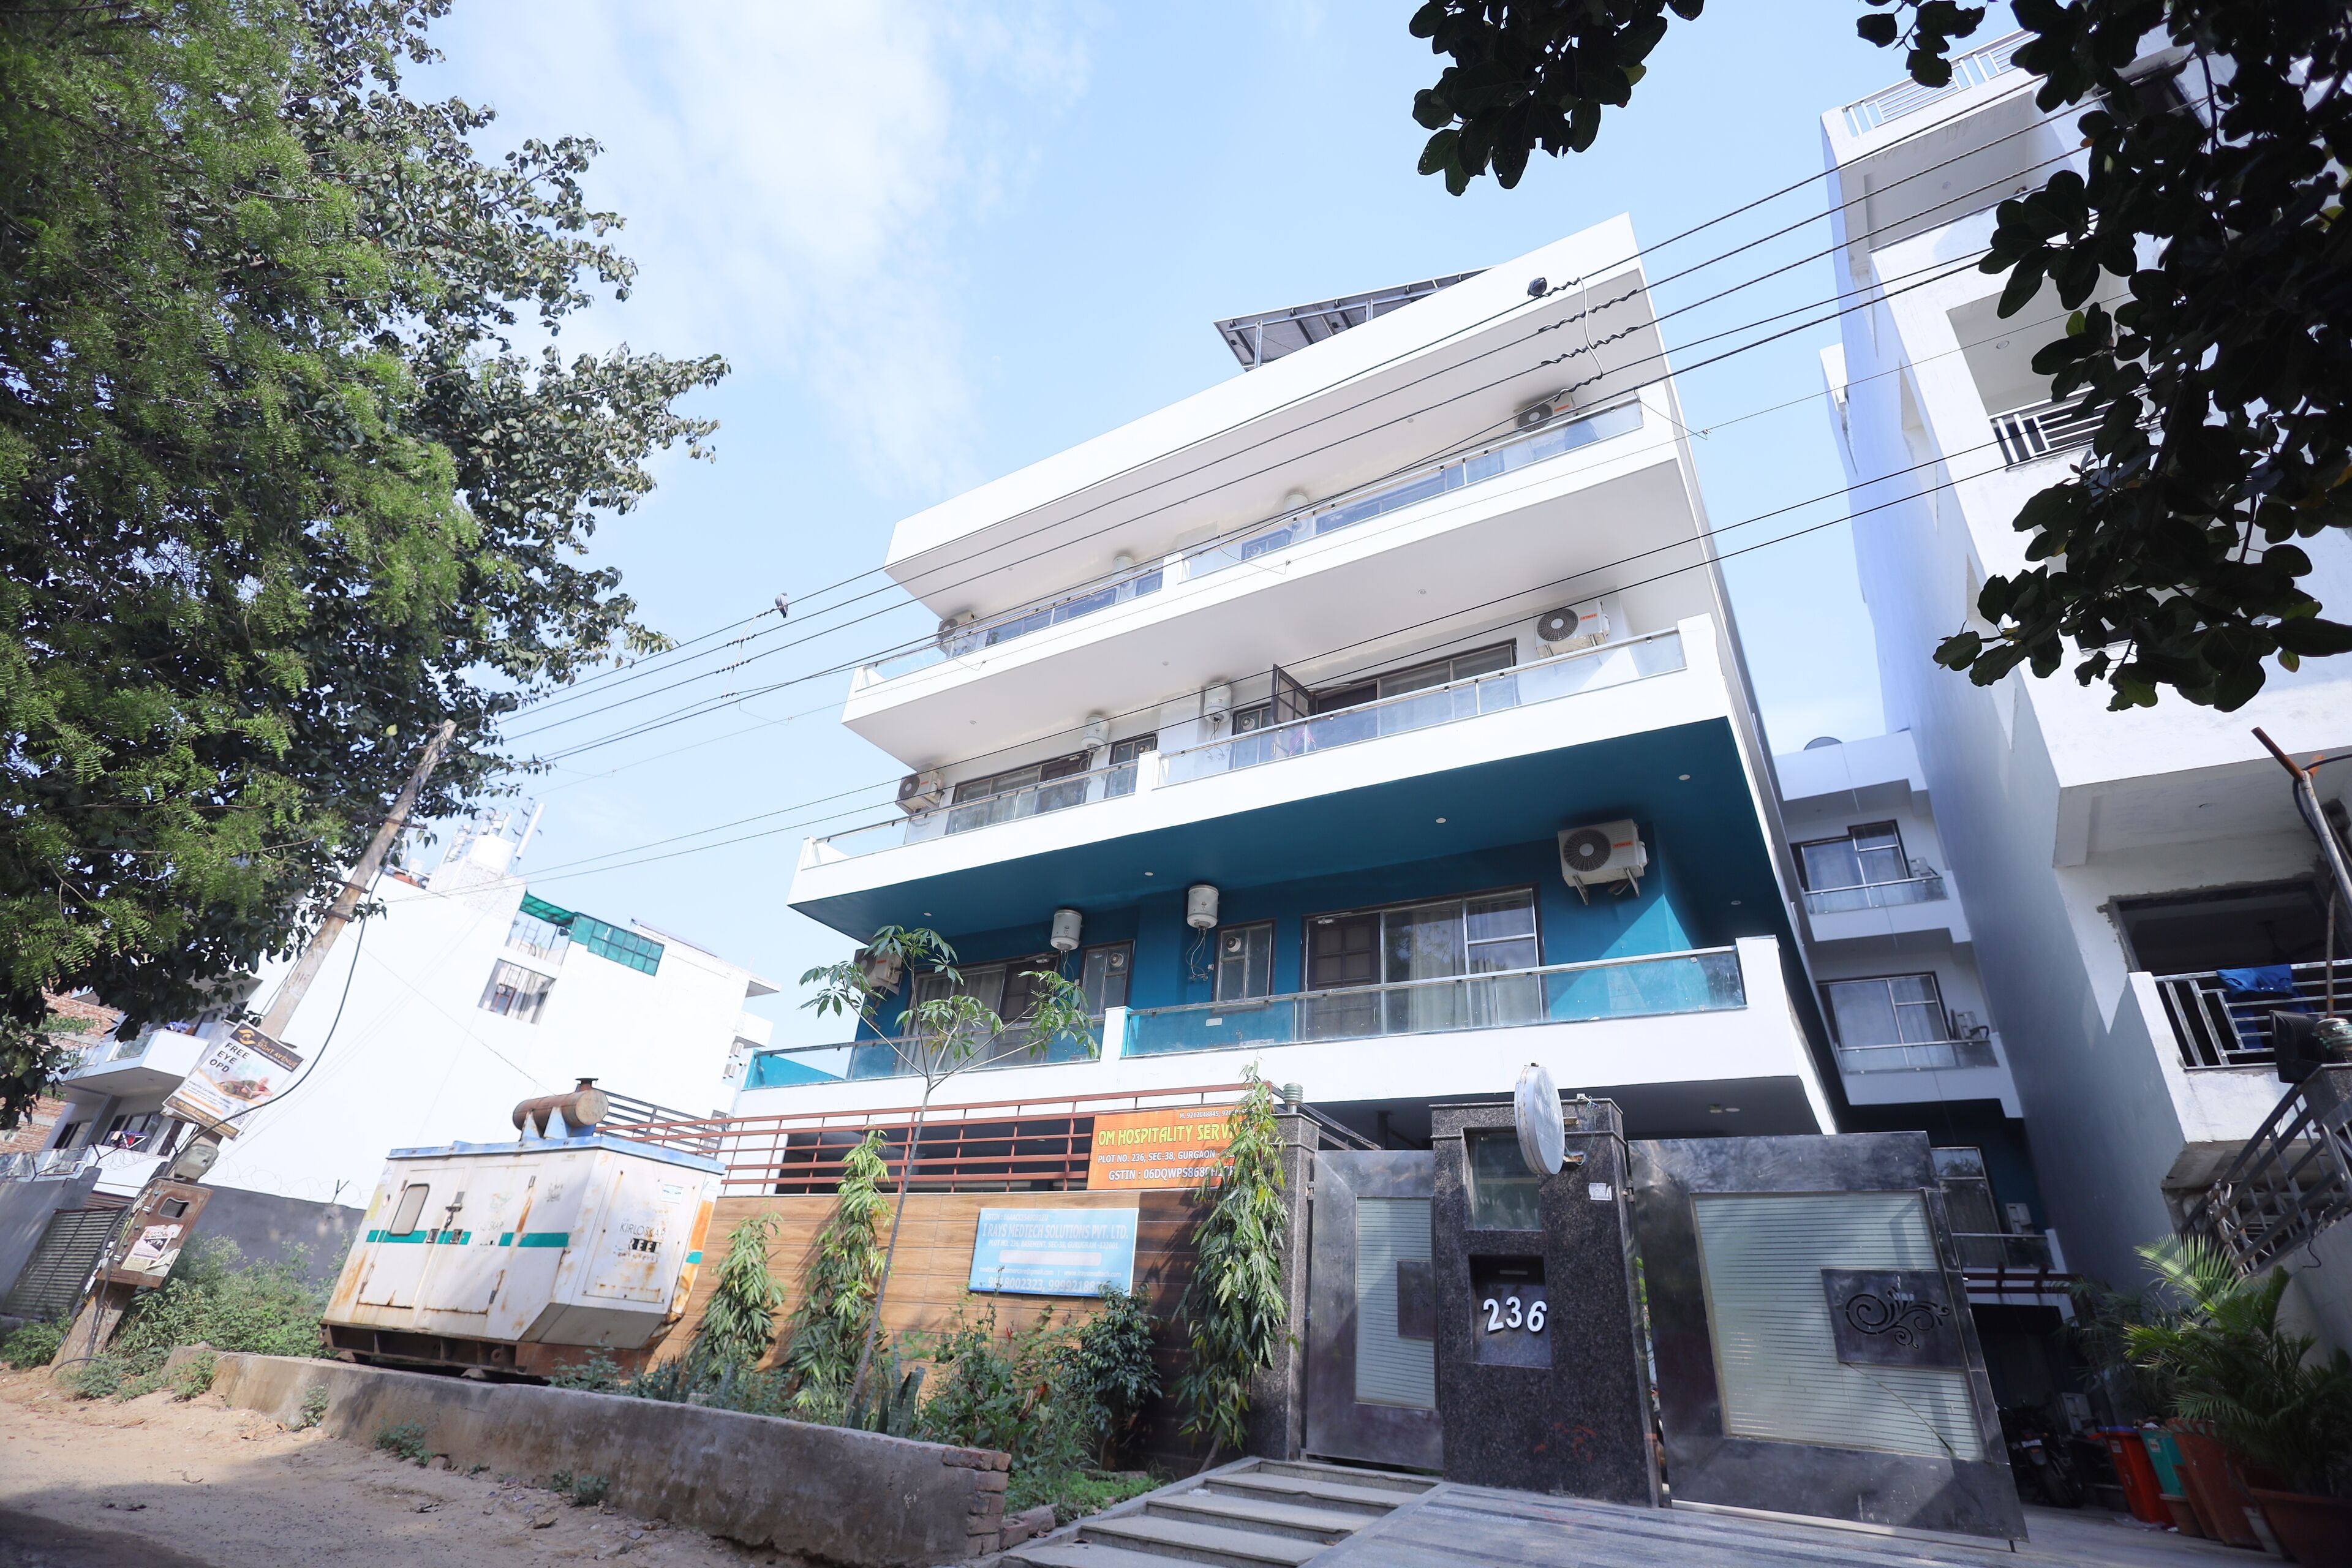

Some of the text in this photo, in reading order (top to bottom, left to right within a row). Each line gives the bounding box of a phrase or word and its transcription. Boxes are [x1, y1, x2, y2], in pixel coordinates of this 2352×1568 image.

[217, 1050, 238, 1065] EYE
[224, 1042, 250, 1060] FREE
[257, 1041, 274, 1054] SIGHT
[274, 1052, 298, 1068] AVENUE
[209, 1058, 230, 1073] OPD
[1098, 1130, 1115, 1146] OM
[1117, 1125, 1194, 1147] HOSPITALITY
[1098, 1155, 1115, 1163] PLOT
[1117, 1154, 1129, 1163] NO.
[1131, 1153, 1146, 1163] 236,
[1148, 1152, 1176, 1162] SEC-38,
[1178, 1150, 1215, 1159] GURGAON
[1109, 1170, 1136, 1180] GSTIN
[619, 1221, 666, 1237] KIRLOSKAR
[987, 1224, 1008, 1237] RAYS
[1008, 1224, 1044, 1238] MEDTECH
[1045, 1224, 1090, 1238] SOLUTIONS
[1091, 1224, 1108, 1238] PVT.
[1110, 1225, 1129, 1239] LTD.
[1483, 1296, 1547, 1332] 236
